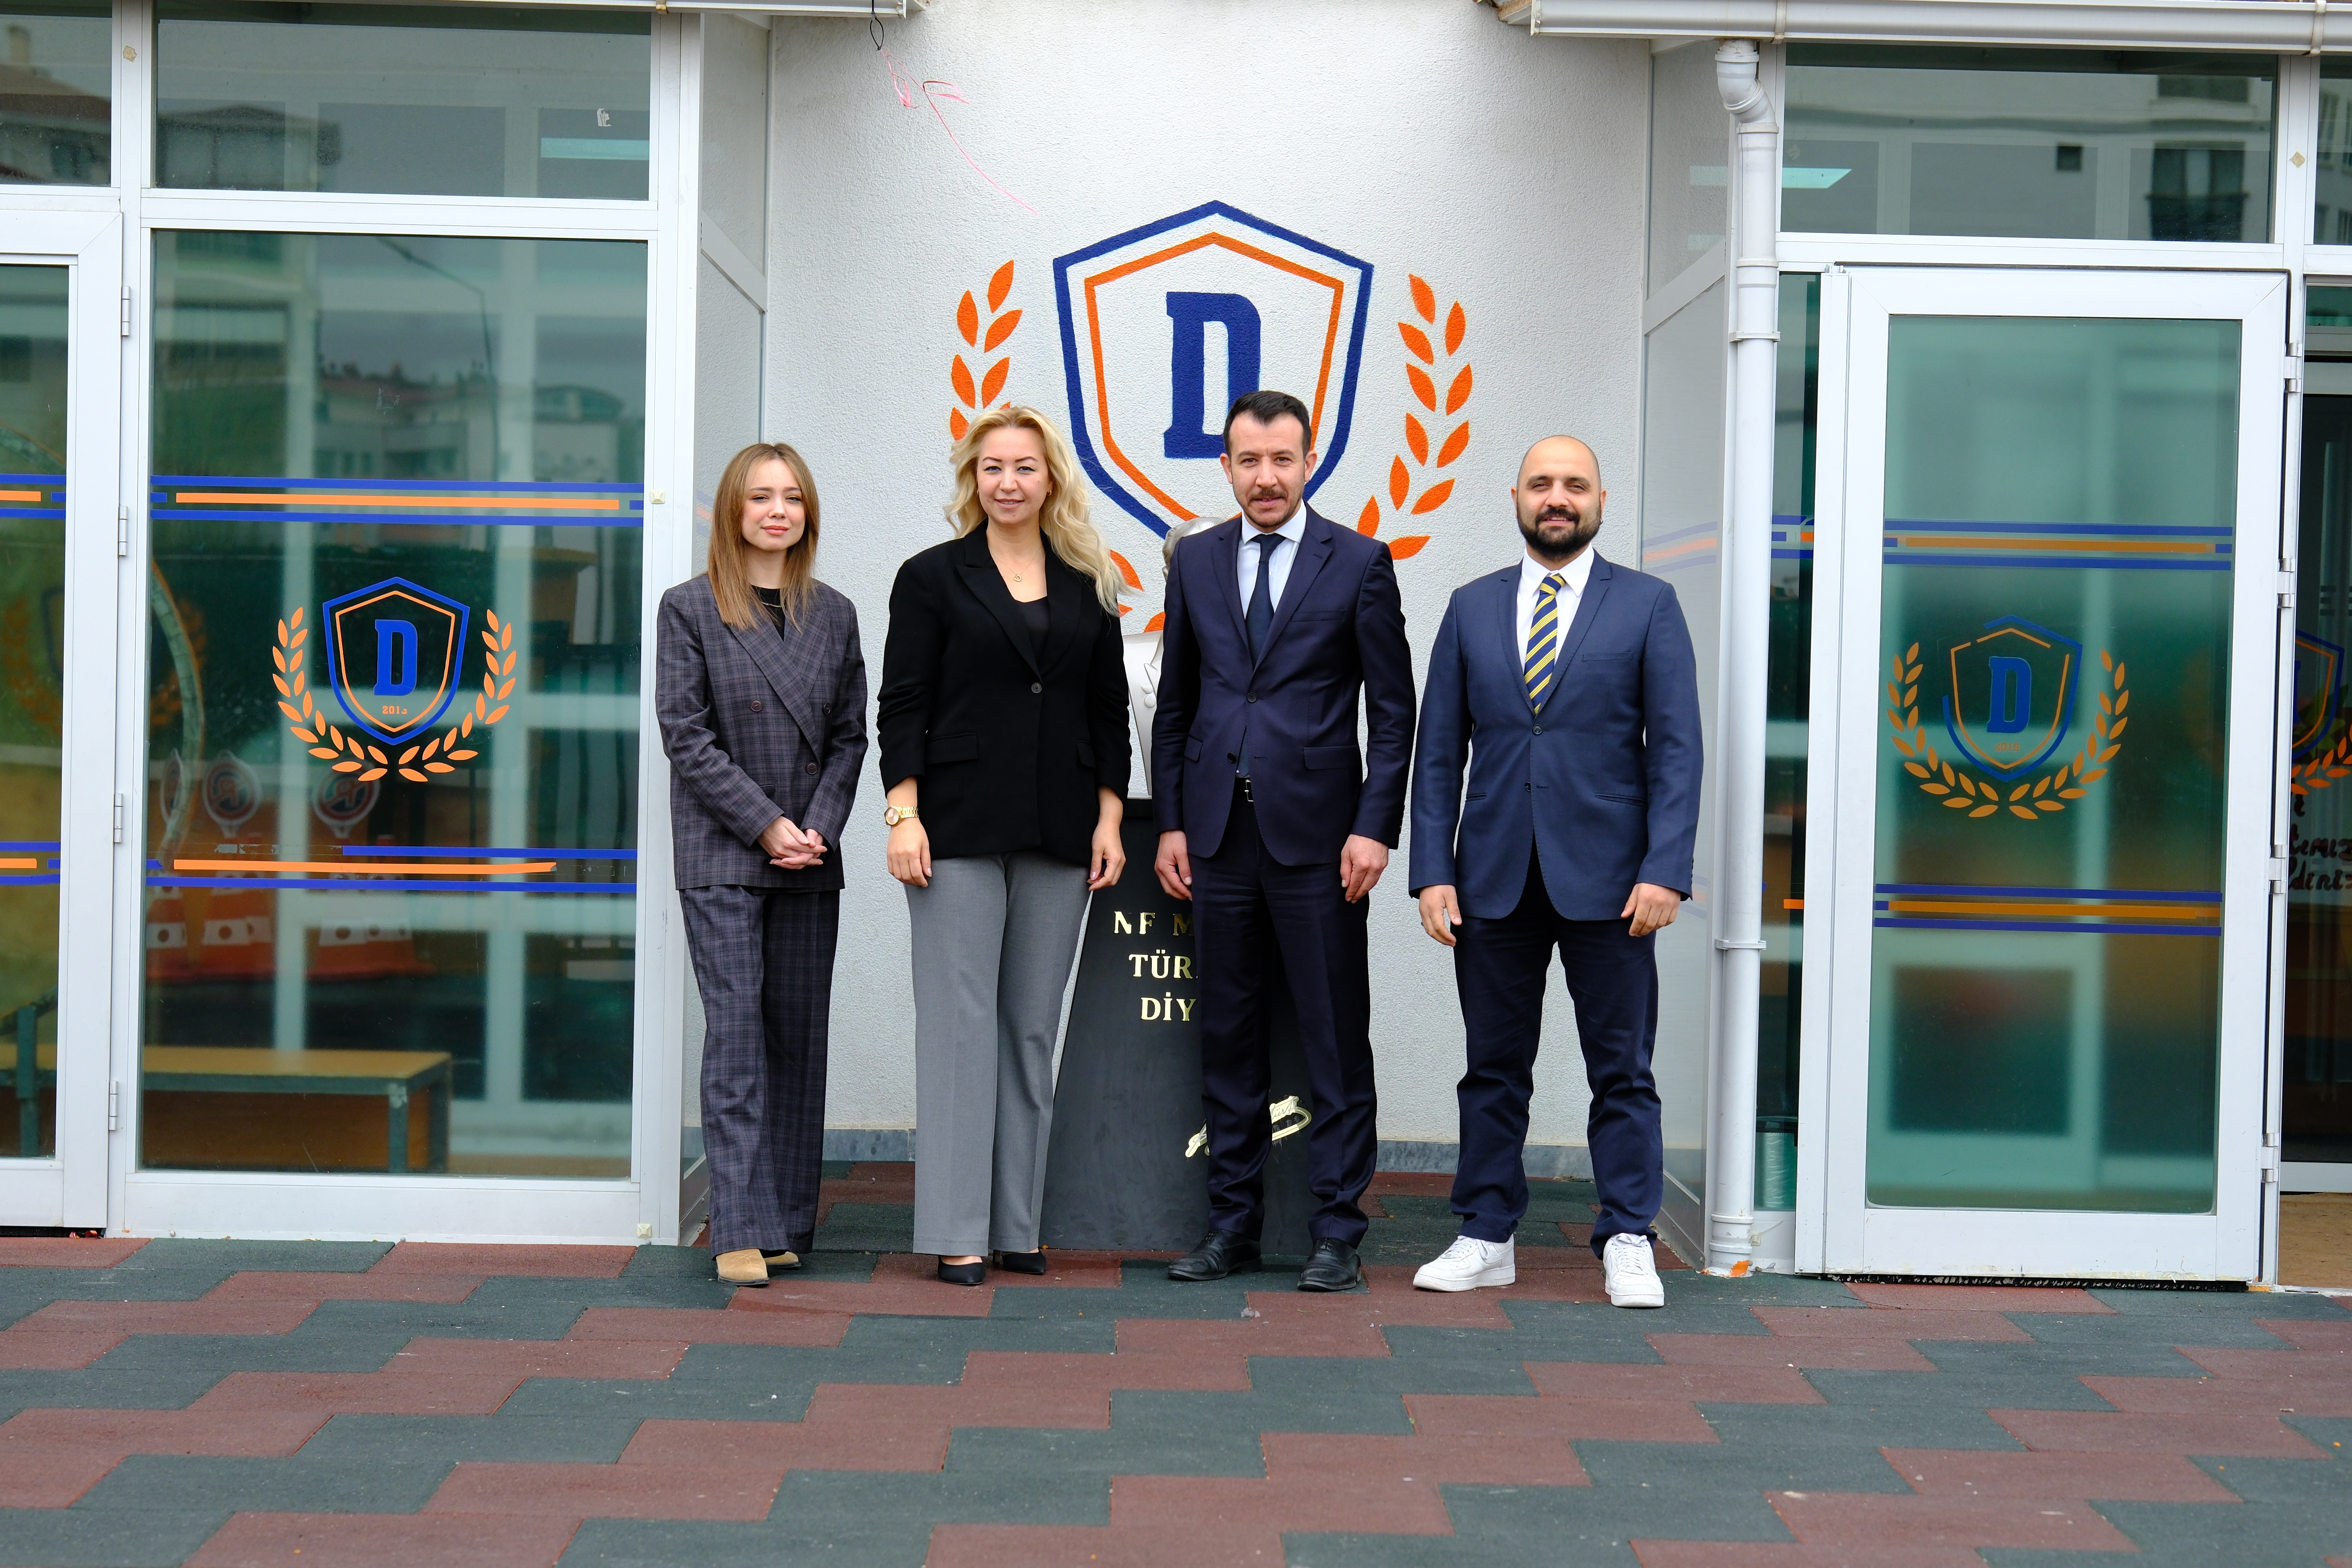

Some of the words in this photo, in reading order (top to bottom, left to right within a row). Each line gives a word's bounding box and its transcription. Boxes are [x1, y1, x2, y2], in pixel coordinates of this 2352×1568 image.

[1164, 291, 1261, 459] D
[374, 619, 418, 696] D
[1987, 656, 2031, 733] D
[1129, 949, 1198, 978] TÜR
